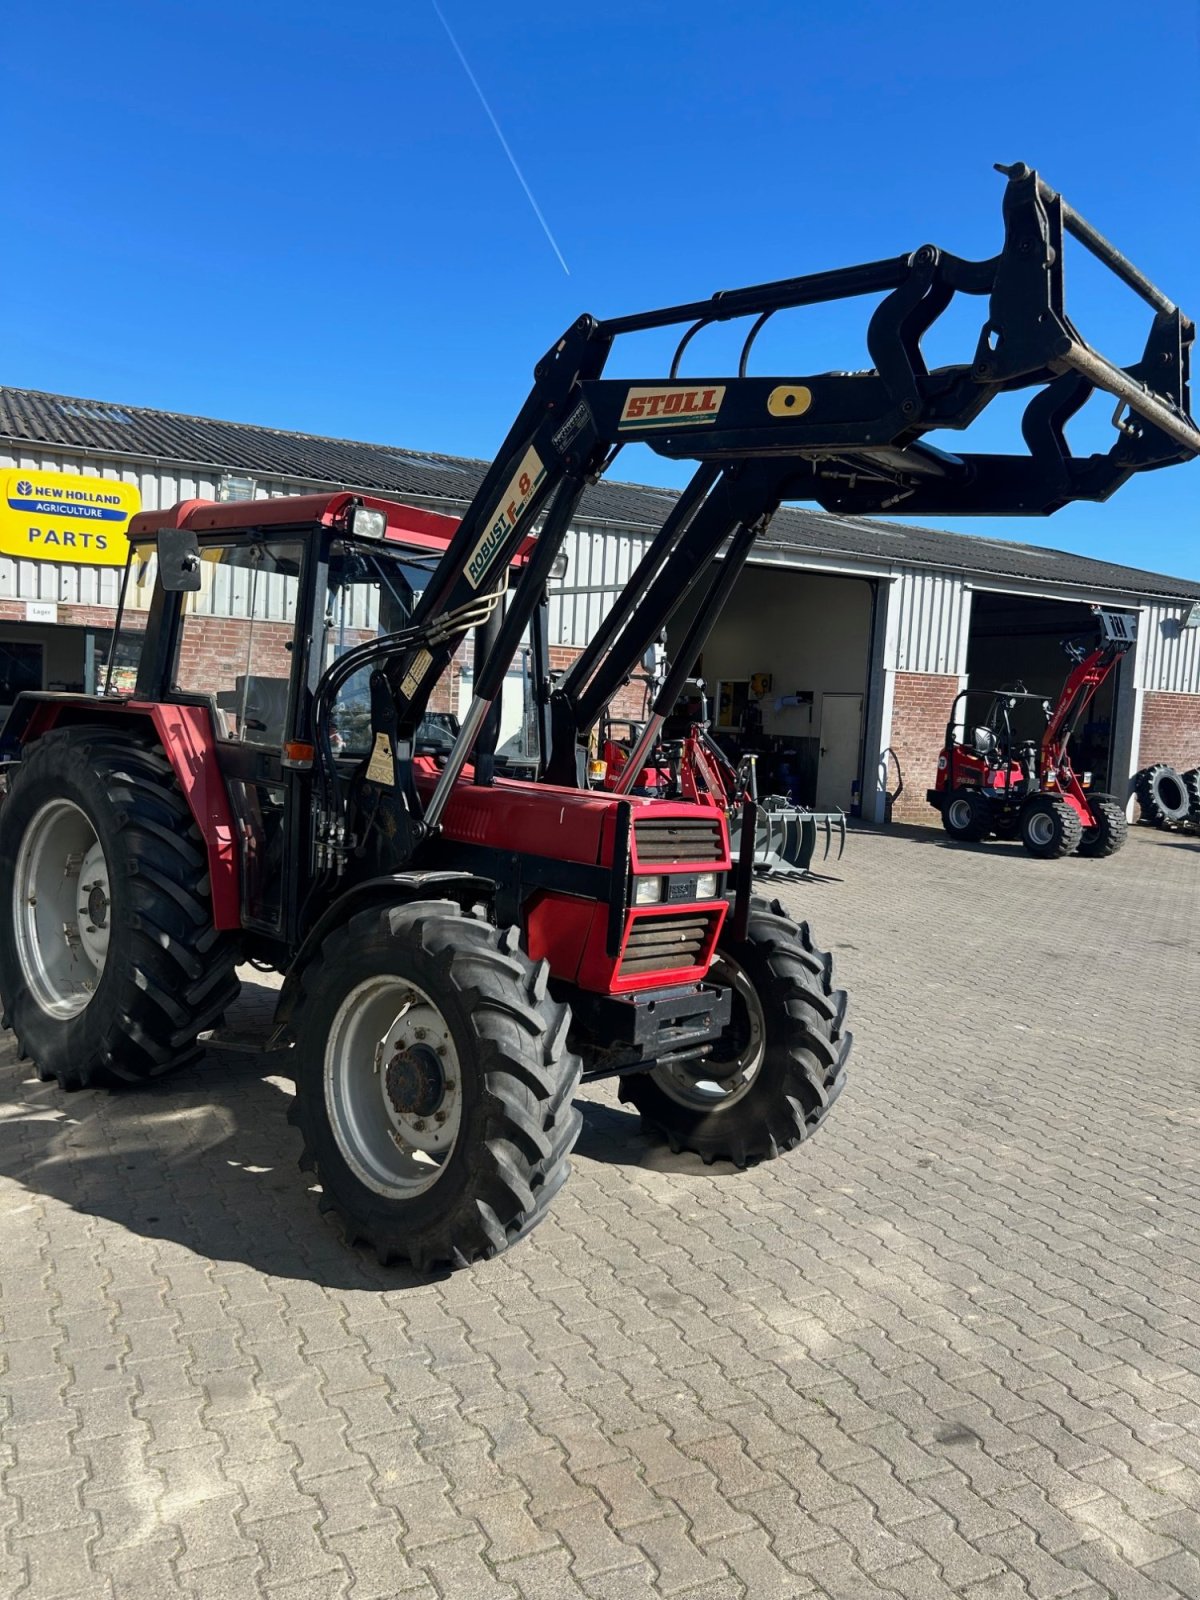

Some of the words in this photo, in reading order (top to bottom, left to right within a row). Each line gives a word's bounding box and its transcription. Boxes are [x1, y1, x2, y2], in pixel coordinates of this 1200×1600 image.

[626, 389, 716, 418] STOLL
[35, 486, 63, 498] NEW
[66, 489, 121, 505] HOLLAND
[36, 503, 102, 518] AGRICULTURE
[468, 513, 508, 580] ROBUST
[506, 501, 517, 526] F
[518, 472, 531, 496] 8
[28, 527, 107, 550] PARTS
[33, 608, 51, 616] Lager
